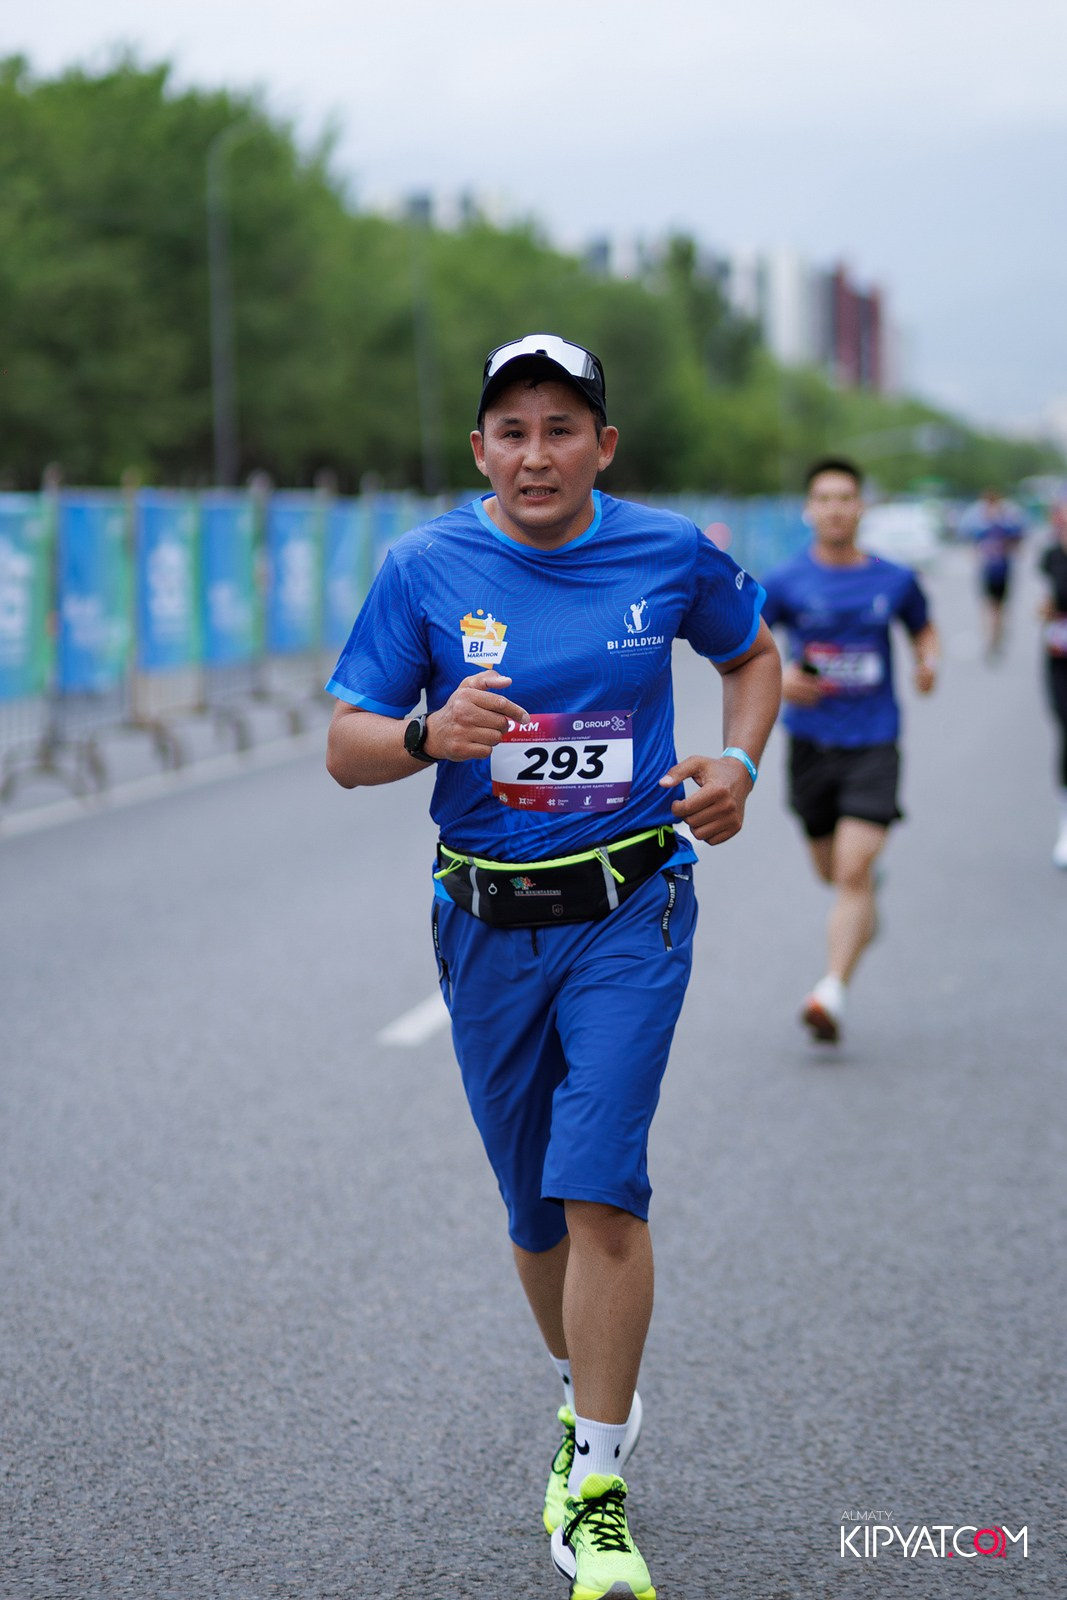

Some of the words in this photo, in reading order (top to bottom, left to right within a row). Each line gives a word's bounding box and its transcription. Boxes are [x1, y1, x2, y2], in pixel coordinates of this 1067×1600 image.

[469, 640, 484, 652] BI
[607, 640, 619, 650] BI
[621, 635, 665, 649] JULDYZAI
[467, 651, 499, 659] MARATHON
[584, 720, 611, 729] GROUP
[517, 745, 609, 781] 293
